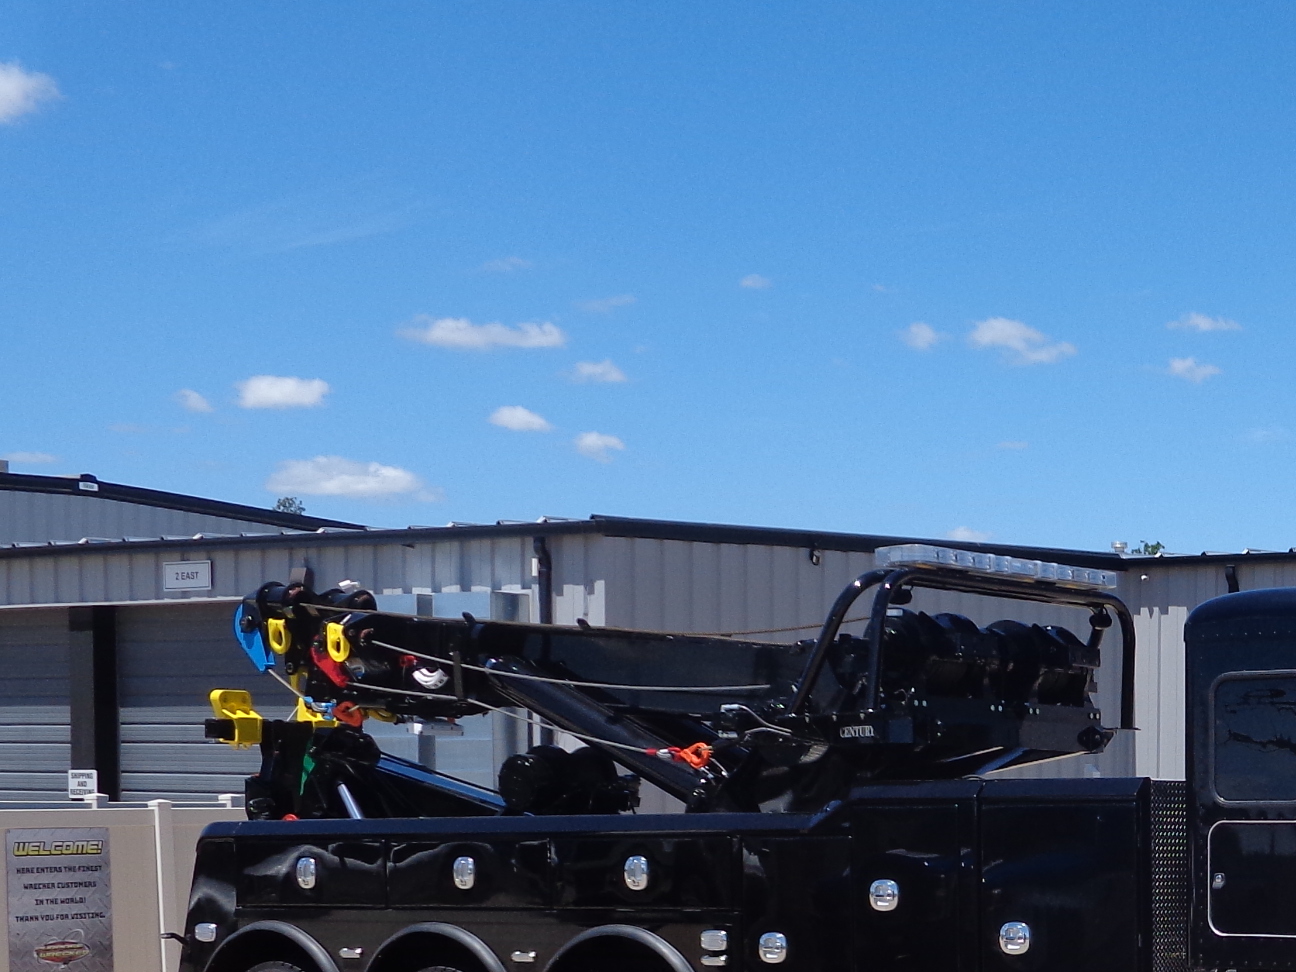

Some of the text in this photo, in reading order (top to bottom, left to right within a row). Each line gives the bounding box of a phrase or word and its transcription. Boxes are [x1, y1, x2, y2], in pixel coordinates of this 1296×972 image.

[175, 571, 199, 581] 2 EAST
[71, 772, 94, 780] SHIPPING
[13, 840, 104, 856] WELCOME!
[16, 866, 35, 875] HERE
[64, 865, 76, 873] THE
[78, 864, 102, 872] FINEST
[15, 915, 39, 923] THANK
